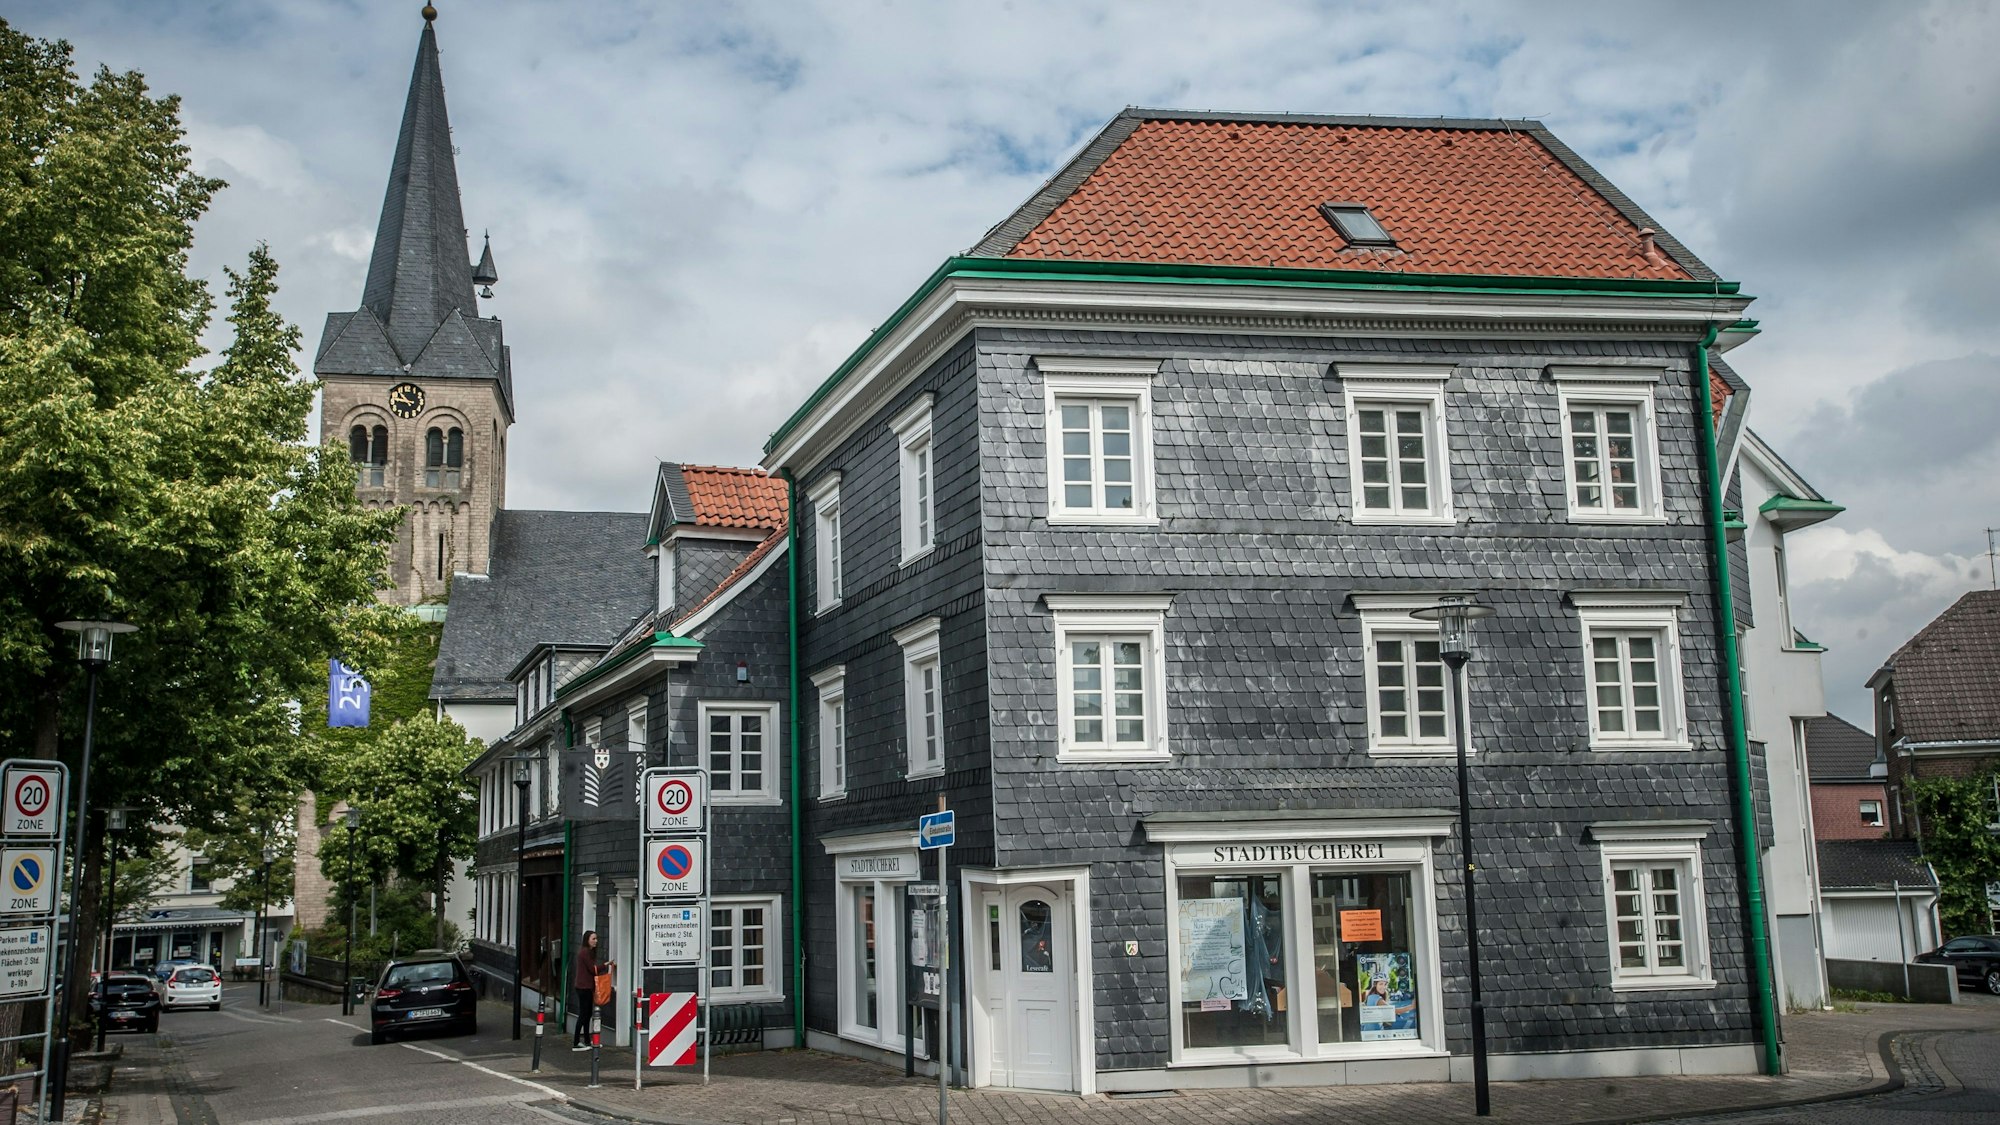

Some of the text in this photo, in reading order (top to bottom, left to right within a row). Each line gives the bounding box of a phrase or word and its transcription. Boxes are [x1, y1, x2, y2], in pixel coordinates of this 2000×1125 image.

[22, 786, 43, 805] 20
[666, 790, 685, 805] 20
[17, 819, 44, 830] ZONE
[662, 816, 688, 826] ZONE
[1214, 842, 1384, 862] STADTBÜCHEREI
[850, 857, 900, 872] STADTBÜCHEREI
[662, 882, 688, 891] ZONE
[11, 898, 38, 909] ZONE
[651, 921, 698, 930] gekennzeichneten
[0, 946, 45, 956] ekennzeichneten
[1, 958, 22, 967] Flächen
[24, 957, 28, 965] 2
[8, 969, 32, 977] werktags
